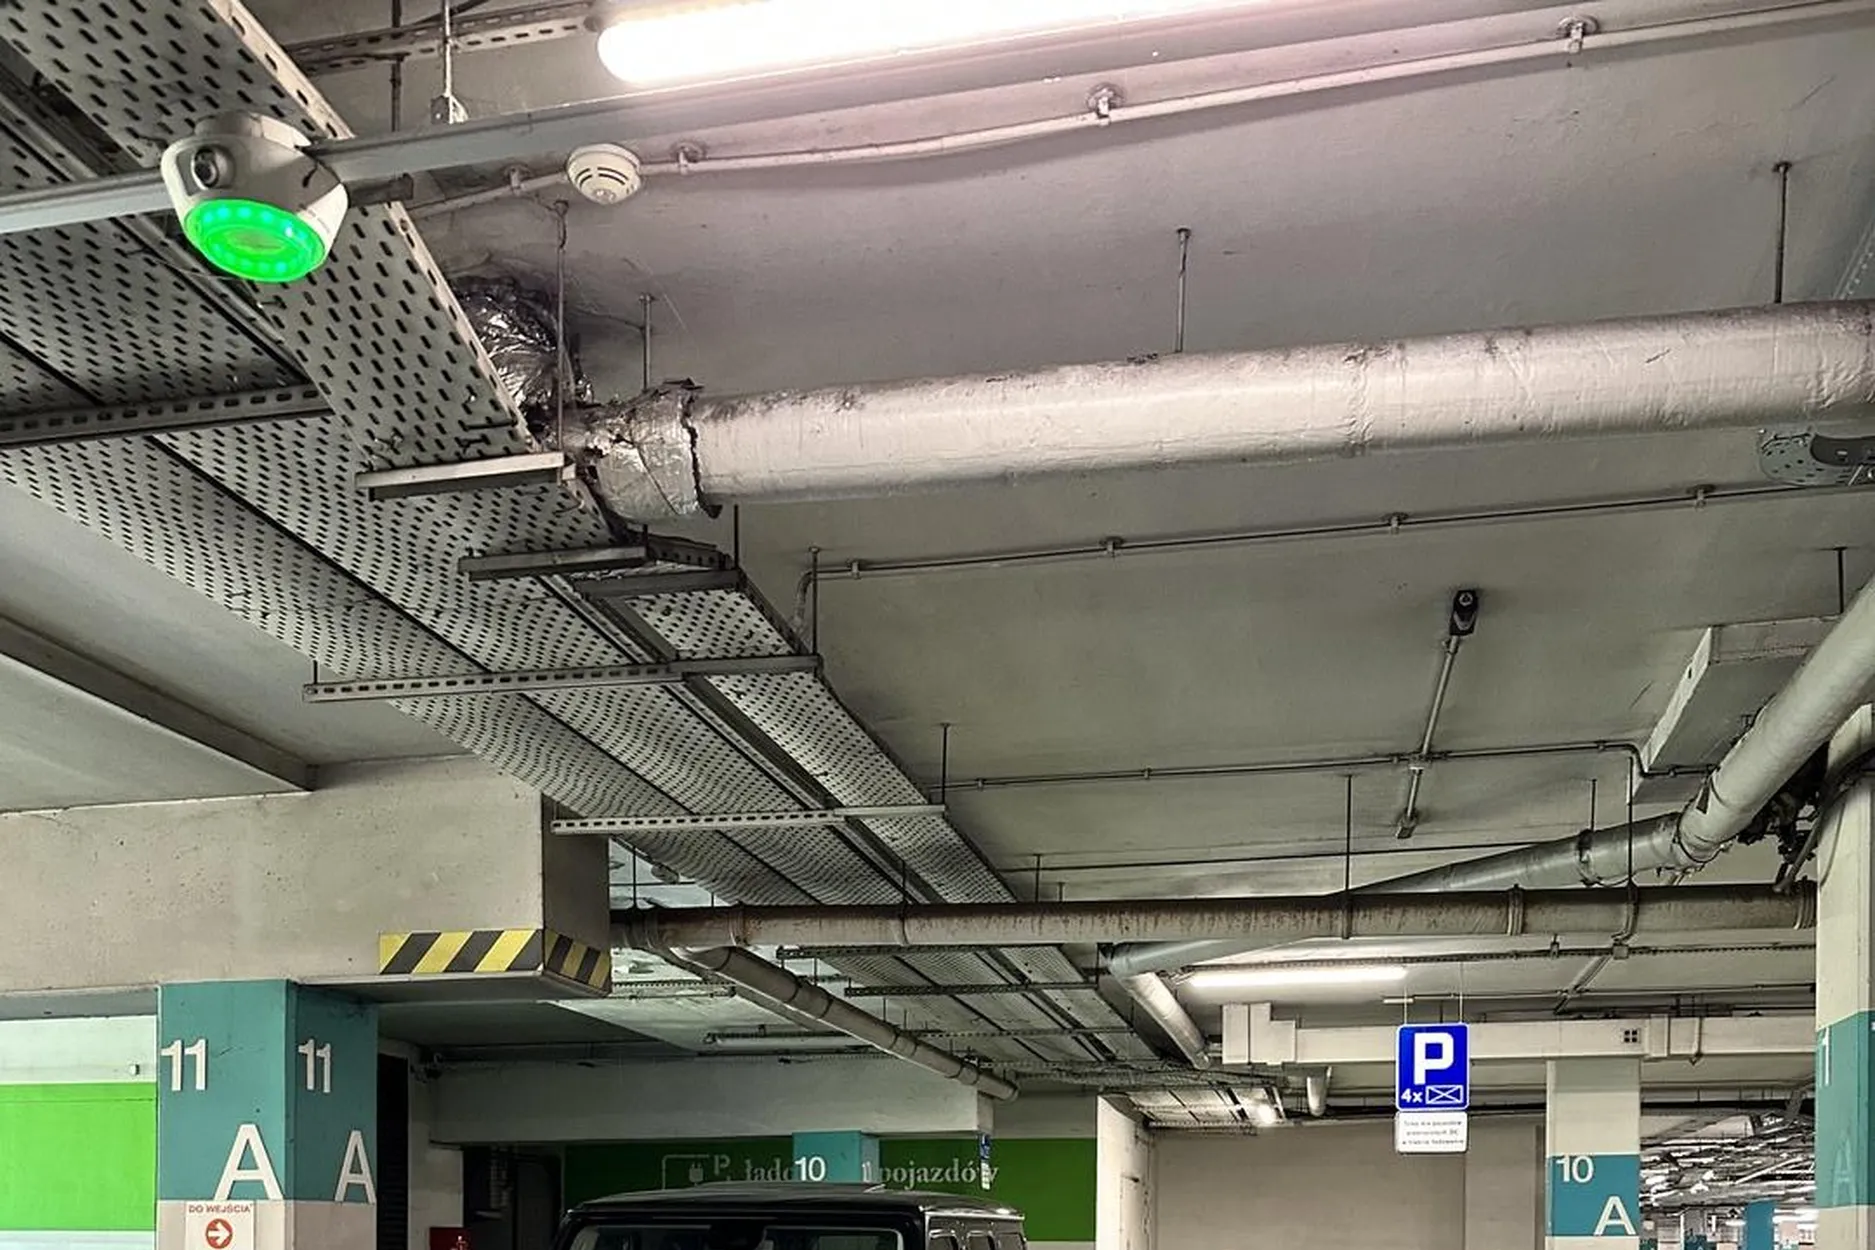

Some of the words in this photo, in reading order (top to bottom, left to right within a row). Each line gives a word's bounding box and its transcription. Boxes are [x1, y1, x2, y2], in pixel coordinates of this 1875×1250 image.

[161, 1038, 206, 1091] 11
[298, 1038, 331, 1092] 11
[1414, 1033, 1454, 1085] P
[1401, 1089, 1423, 1103] 4x
[214, 1124, 283, 1200] A
[335, 1131, 377, 1203] A
[795, 1156, 826, 1182] 10
[1556, 1154, 1594, 1184] 10
[189, 1204, 204, 1213] DO
[1594, 1196, 1637, 1236] A
